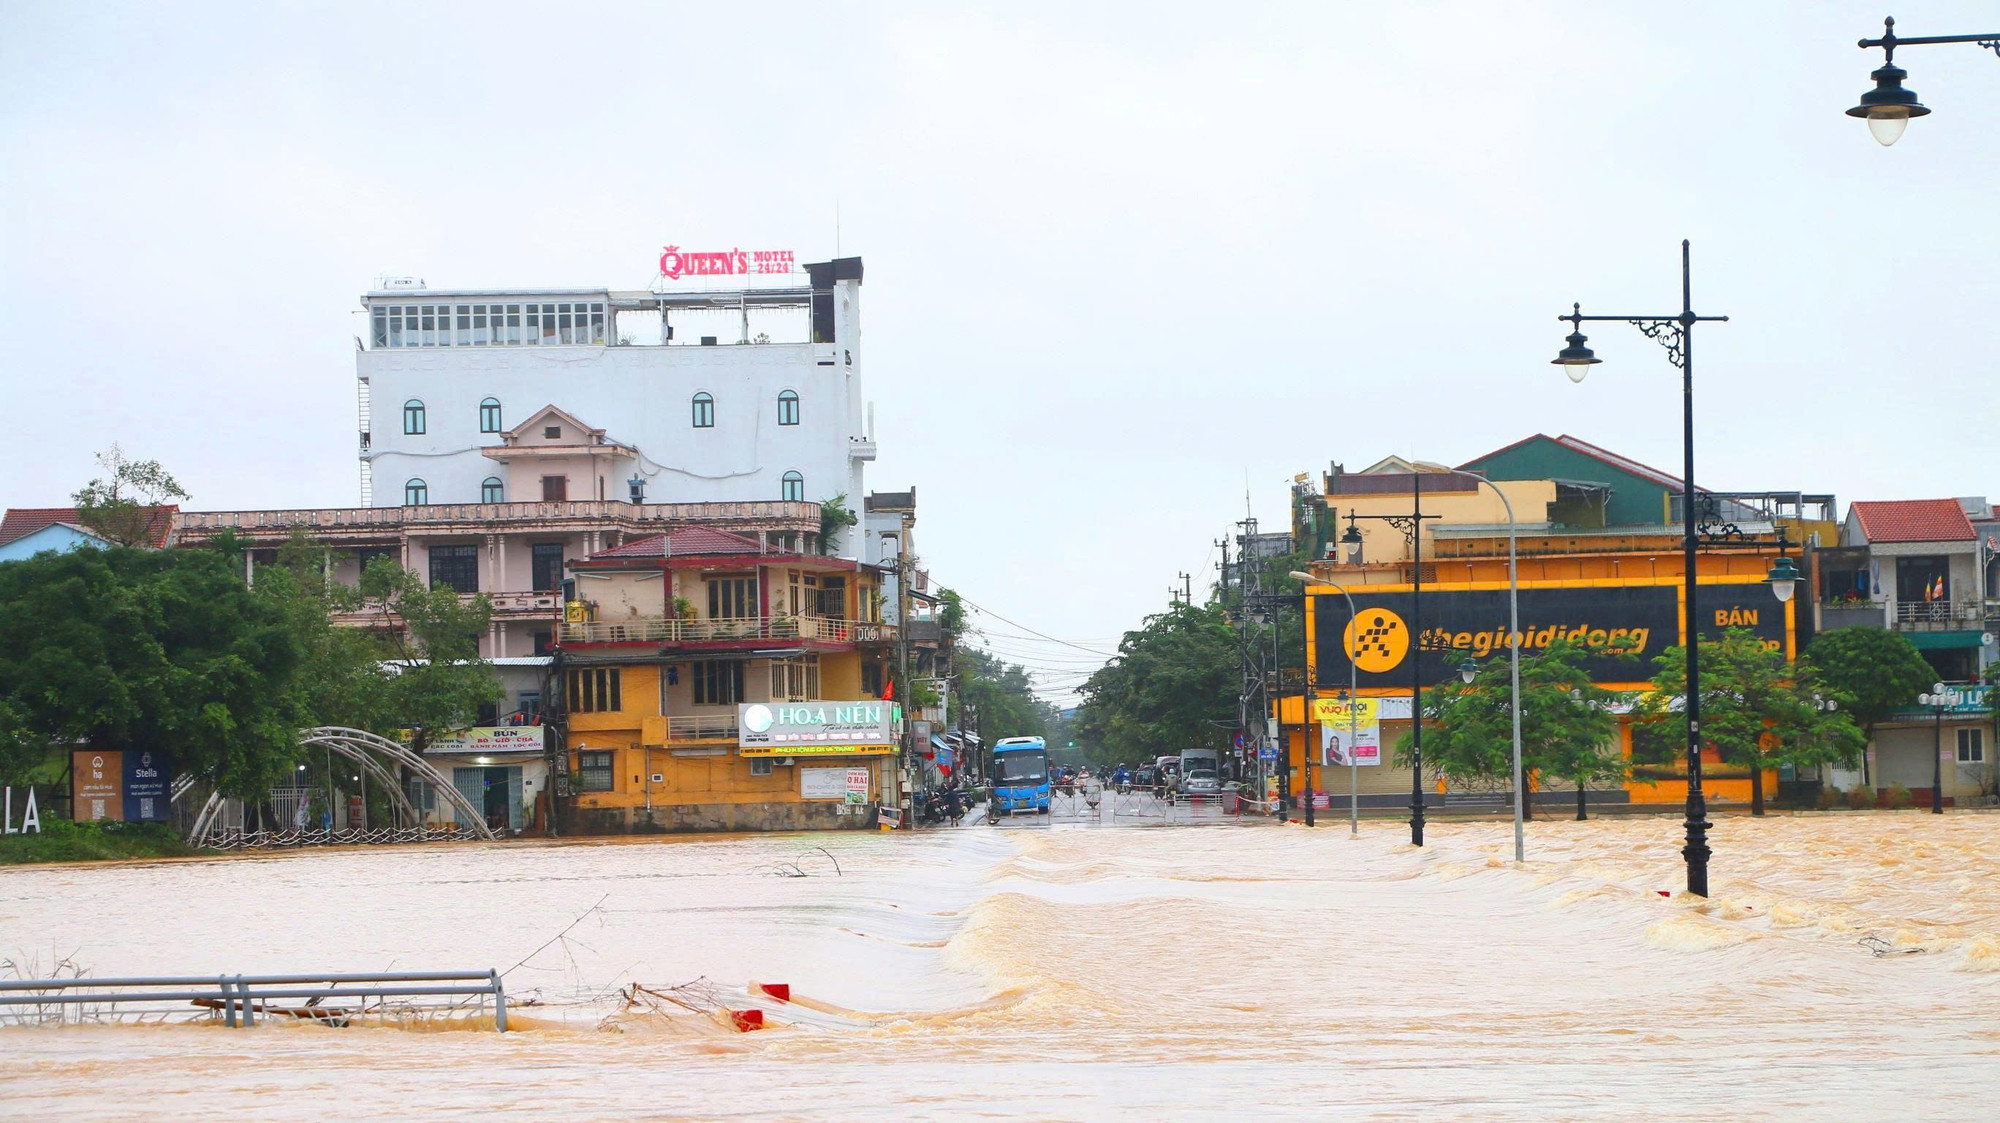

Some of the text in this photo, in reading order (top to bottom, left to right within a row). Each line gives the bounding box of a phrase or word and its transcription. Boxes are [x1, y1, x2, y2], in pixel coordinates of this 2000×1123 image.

[660, 247, 794, 280] QUEEN'S MOTEL
[757, 262, 789, 274] 24/24
[1715, 605, 1758, 626] BÁN
[779, 707, 827, 725] HOA
[135, 768, 158, 778] Stella
[0, 785, 41, 834] LA
